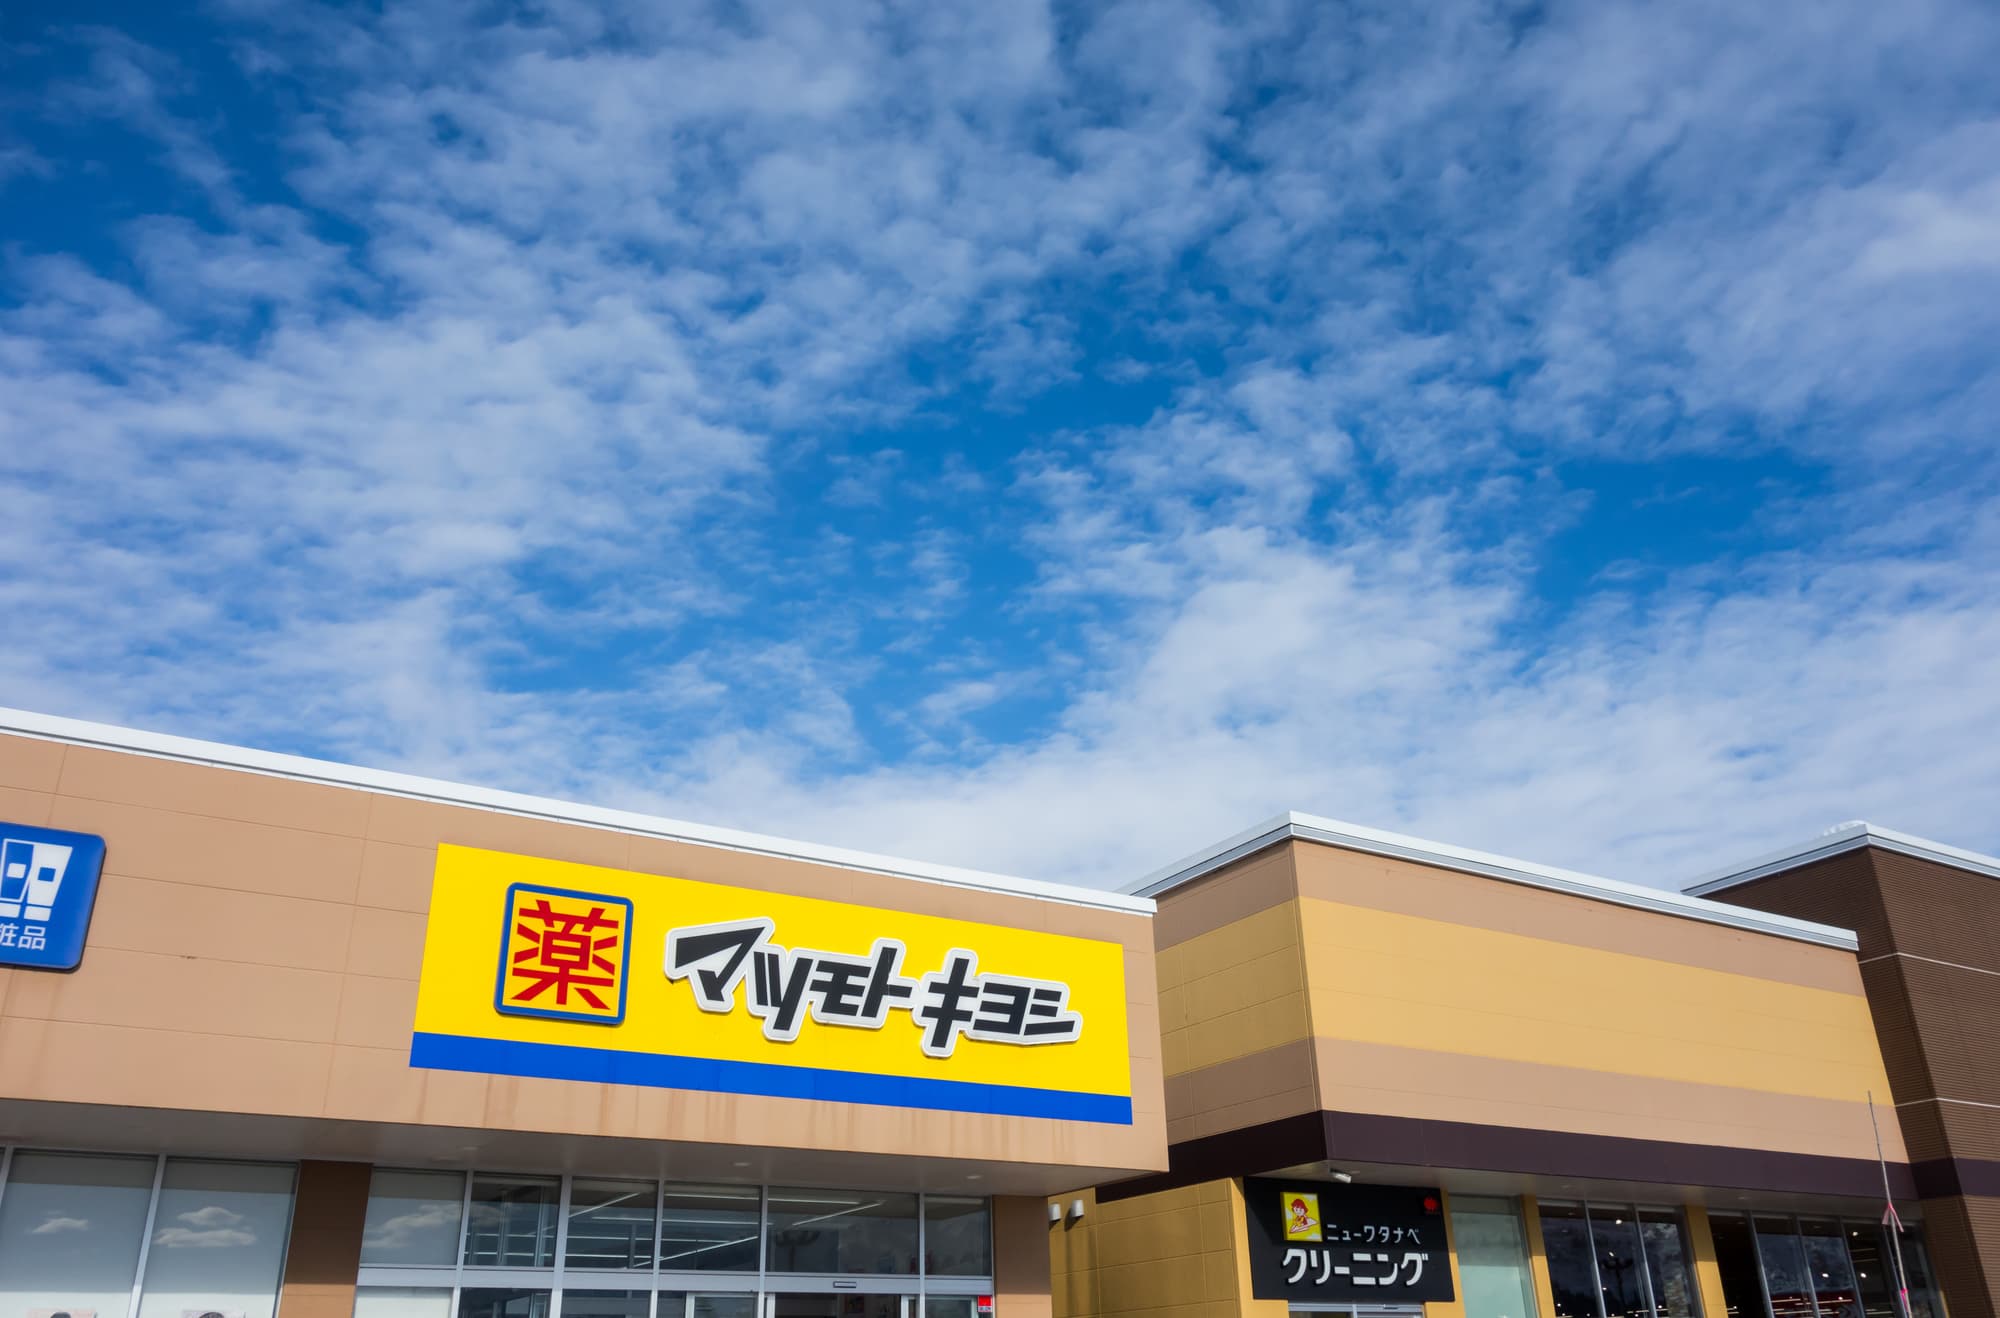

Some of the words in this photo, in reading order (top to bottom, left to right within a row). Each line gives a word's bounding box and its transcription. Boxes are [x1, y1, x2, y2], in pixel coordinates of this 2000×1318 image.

[511, 900, 619, 1010] 薬
[672, 924, 1078, 1050] マツモトキヨシ
[1282, 1248, 1429, 1287] クリーニング
[1326, 1223, 1421, 1245] ニューワタナベ
